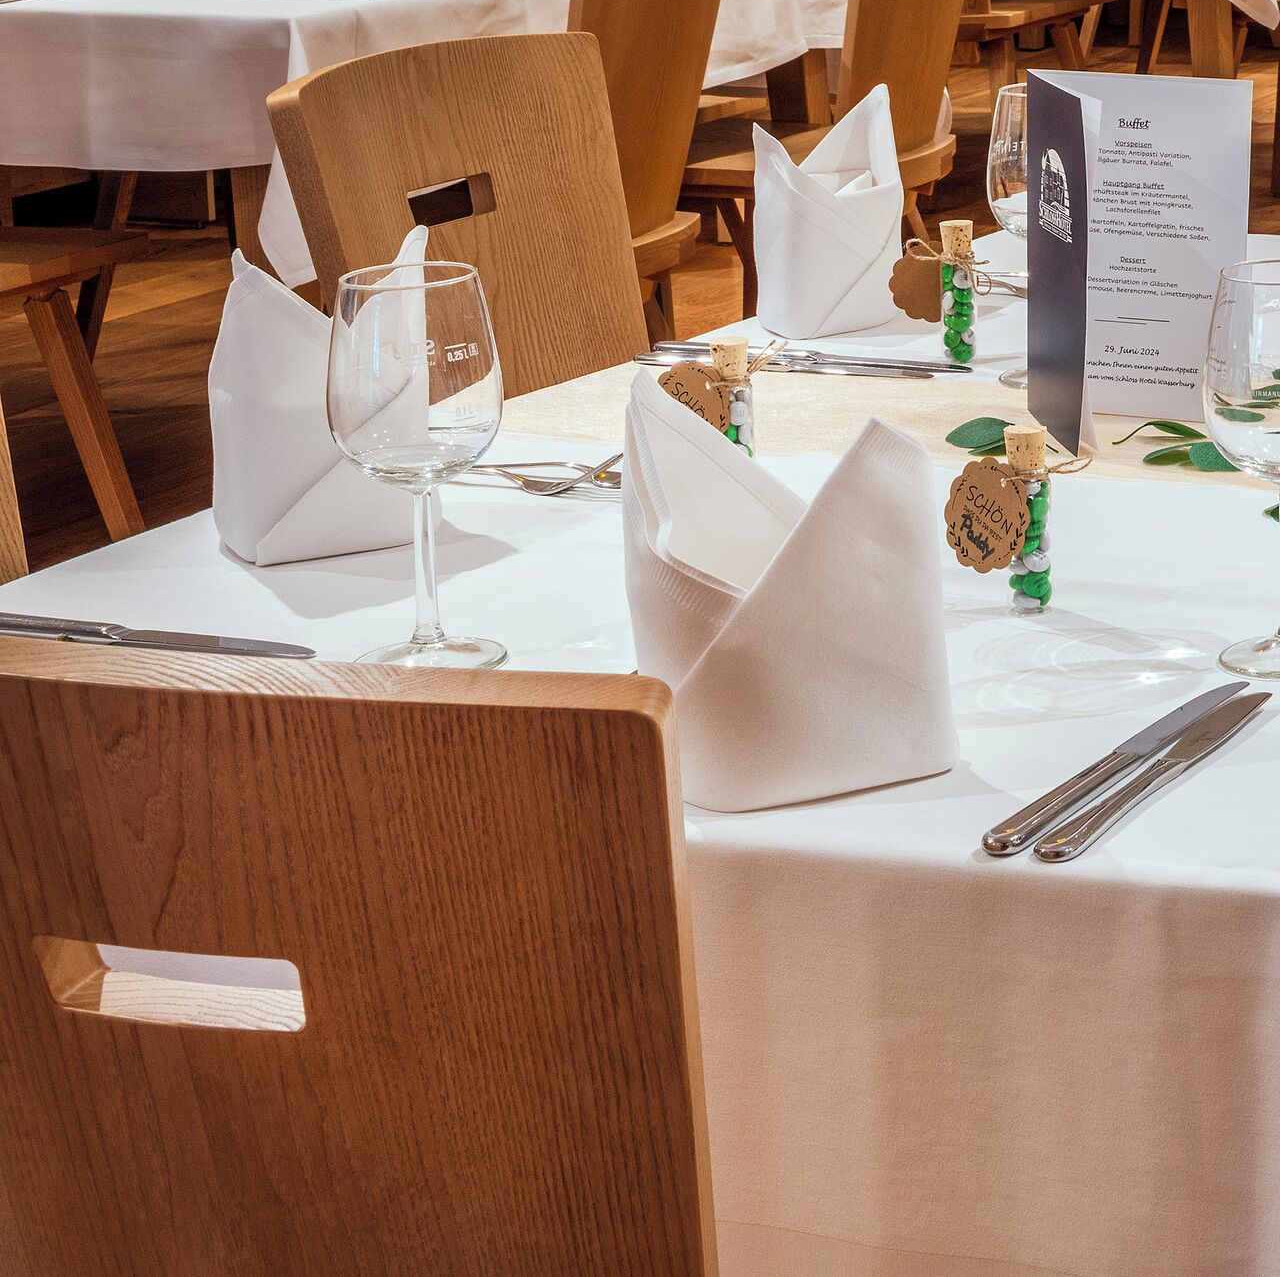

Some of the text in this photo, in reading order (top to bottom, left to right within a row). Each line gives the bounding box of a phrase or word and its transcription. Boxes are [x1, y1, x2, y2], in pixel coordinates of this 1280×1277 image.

[1118, 118, 1150, 129] Buffet
[1114, 140, 1152, 148] Vorspeisen
[1099, 148, 1192, 160] Tonnato, Antipasti Variation,
[1103, 180, 1141, 189] Hauptgang
[1141, 192, 1190, 200] Kräutermantel,
[1153, 201, 1193, 209] Honigkruste,
[1106, 206, 1161, 215] Lachsforellenfilet
[1128, 221, 1177, 231] Kartoffelgratin,
[1104, 228, 1144, 236] Ofengemüse,
[1146, 231, 1187, 239] Verschiedene
[1120, 256, 1146, 264] Dessert
[1110, 265, 1156, 273] Hochzeitstorte
[1088, 277, 1140, 285] Dessertvariation
[1117, 287, 1158, 296] Beerencreme,
[1160, 291, 1212, 299] Limettenjoghurt
[1118, 346, 1139, 354] Juni
[1140, 348, 1160, 356] 2024
[1158, 379, 1195, 389] Wasserburg
[966, 485, 1013, 536] SCHÖN
[959, 513, 995, 561] Paddy
